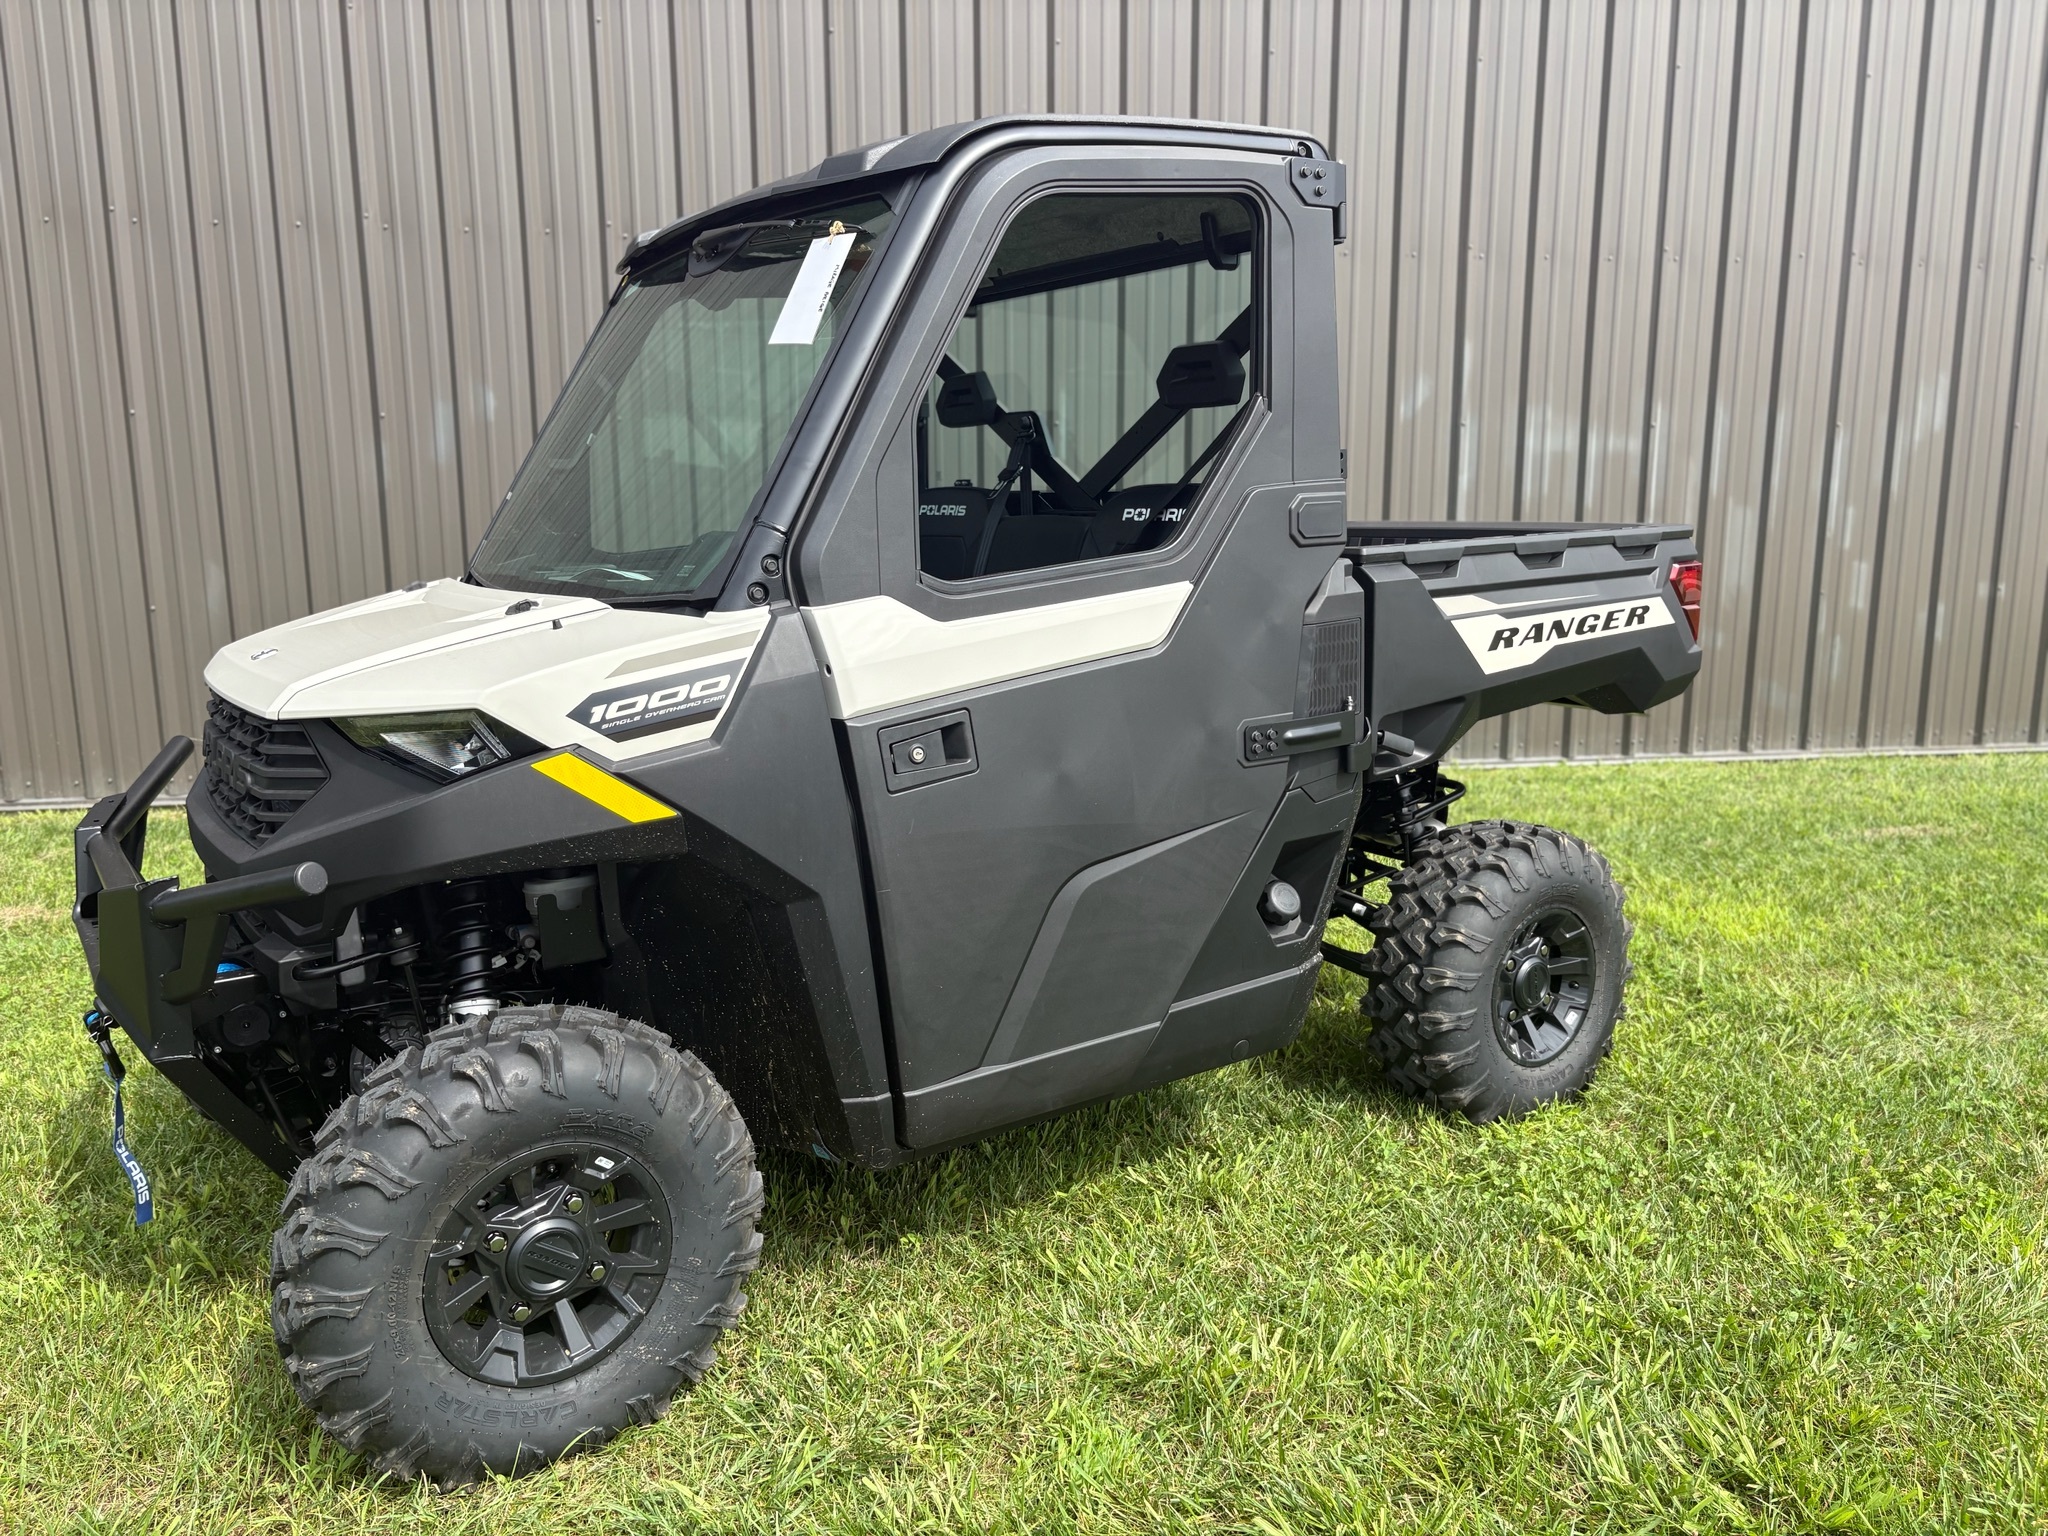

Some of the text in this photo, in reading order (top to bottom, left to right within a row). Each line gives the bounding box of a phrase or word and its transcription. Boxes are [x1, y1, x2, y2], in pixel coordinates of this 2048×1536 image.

[919, 504, 967, 516] POLARIS
[1122, 508, 1187, 521] POLARI
[1487, 605, 1650, 652] RANGER
[589, 674, 731, 725] 1000
[601, 694, 726, 730] SINGLE OVERHEAD CAM
[115, 1124, 150, 1205] POLARIS
[527, 1250, 577, 1272] RANGER
[433, 1394, 579, 1428] CARLSTAR
